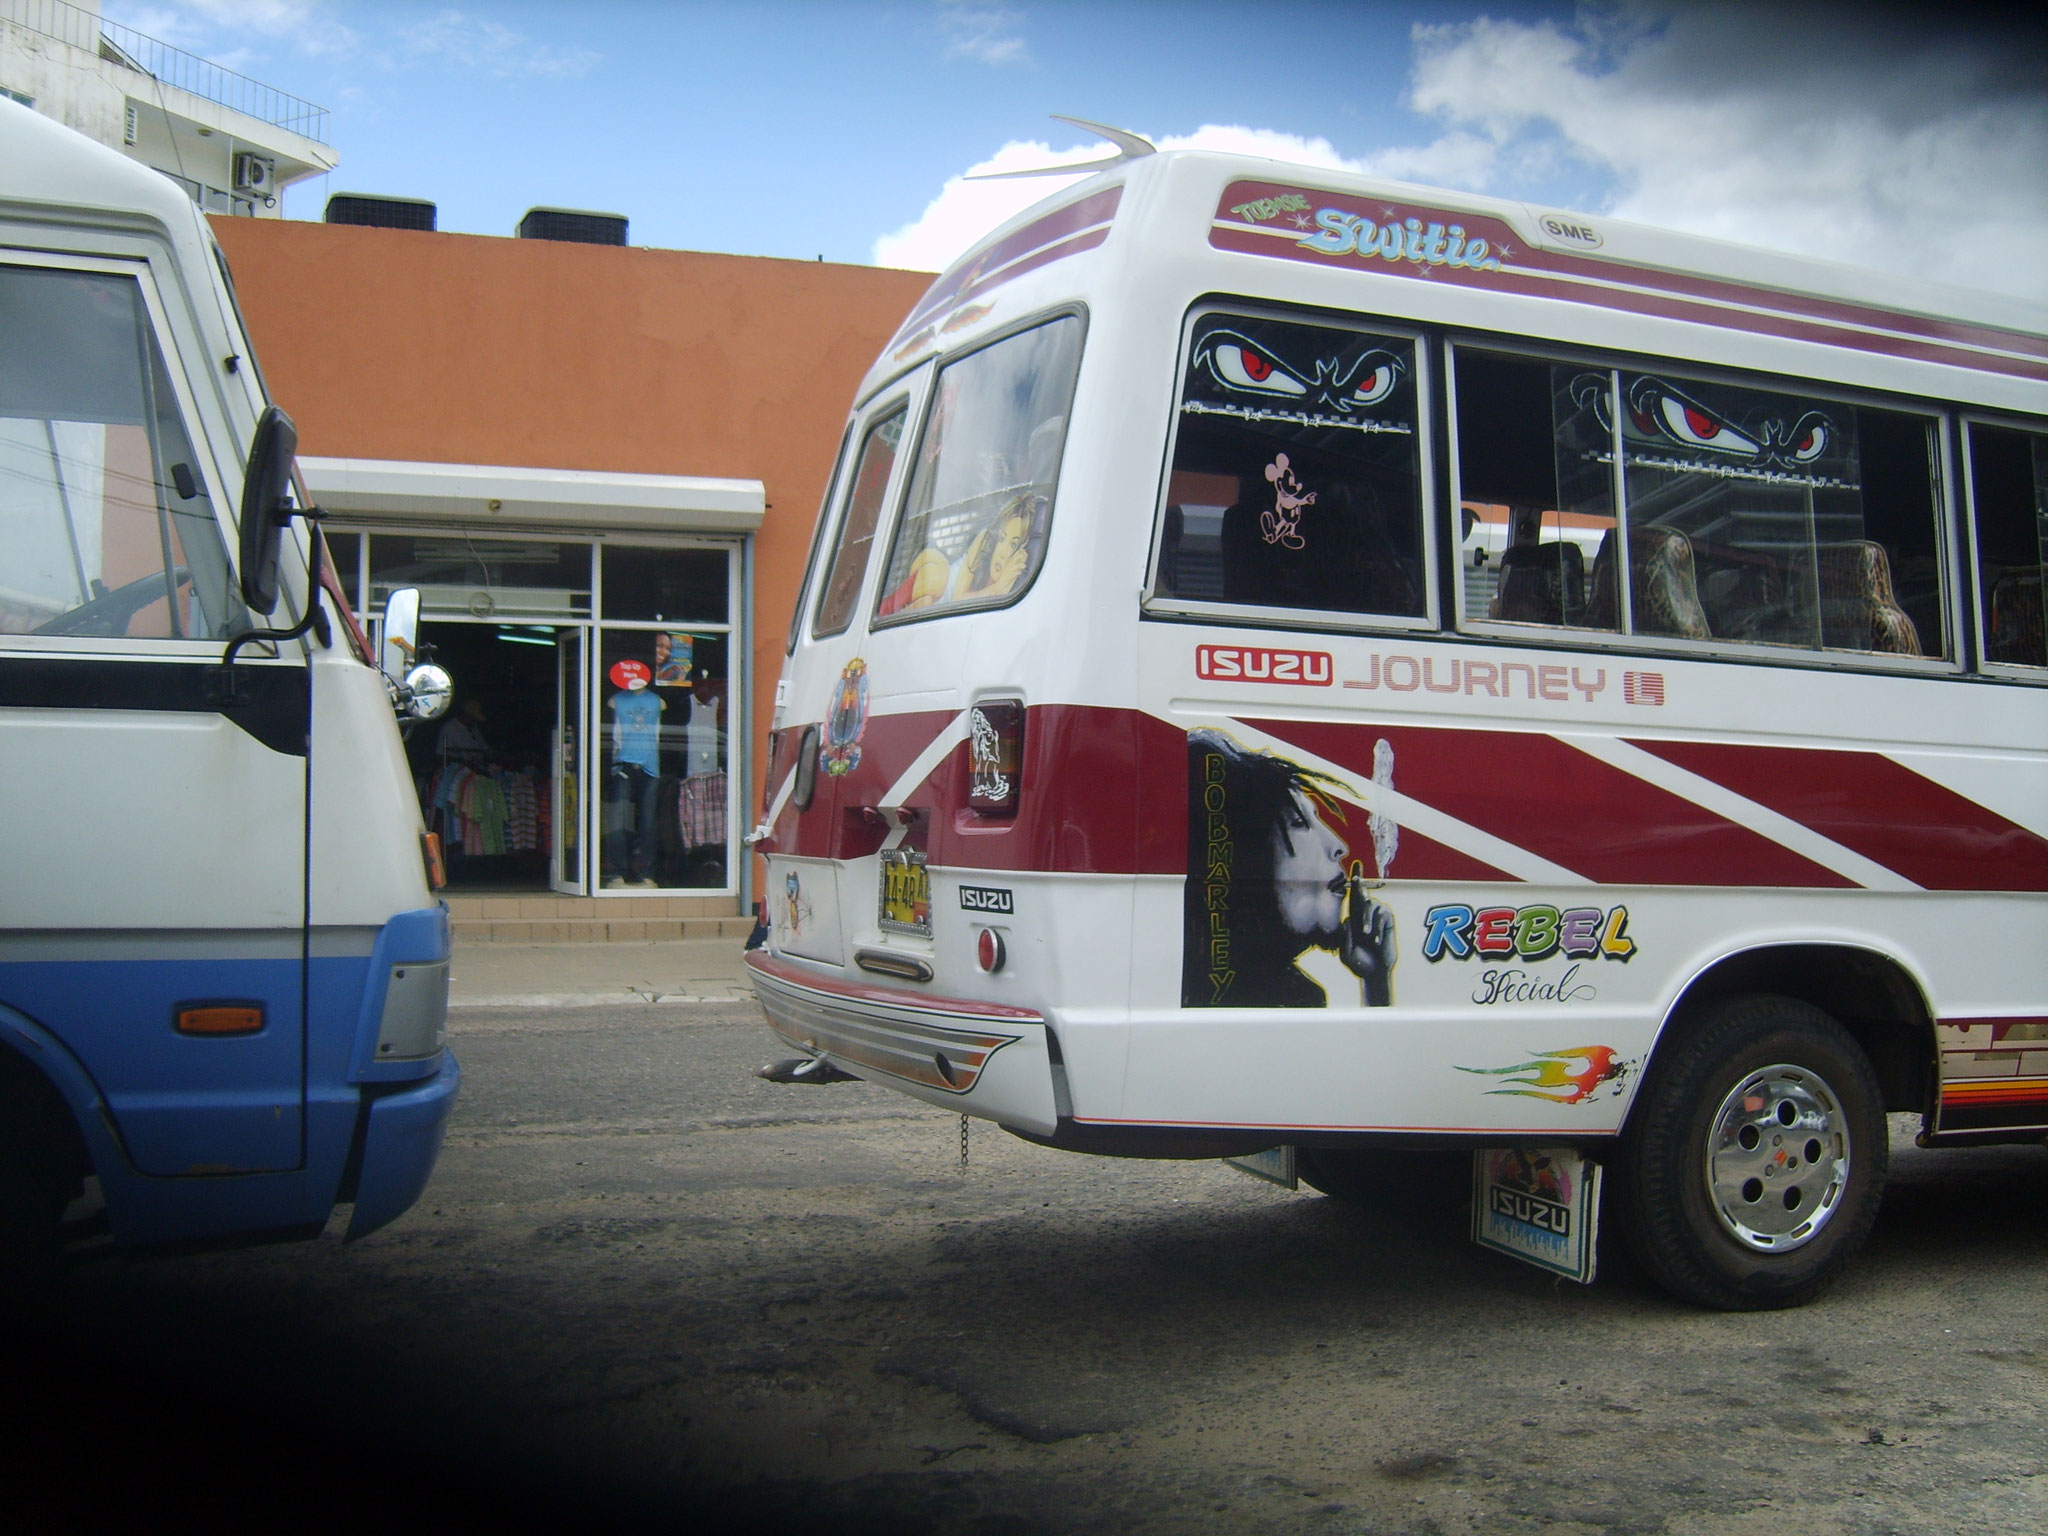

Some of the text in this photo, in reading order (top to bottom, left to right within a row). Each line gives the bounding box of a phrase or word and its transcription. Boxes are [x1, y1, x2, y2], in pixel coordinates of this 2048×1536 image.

[1297, 206, 1502, 273] Switie
[1546, 219, 1597, 243] SME
[1200, 647, 1330, 683] ISUZU
[1342, 653, 1606, 702] JOURNEY
[960, 889, 1012, 911] ISUZU
[1422, 903, 1638, 964] REBEL
[1491, 1187, 1568, 1234] ISUZU
